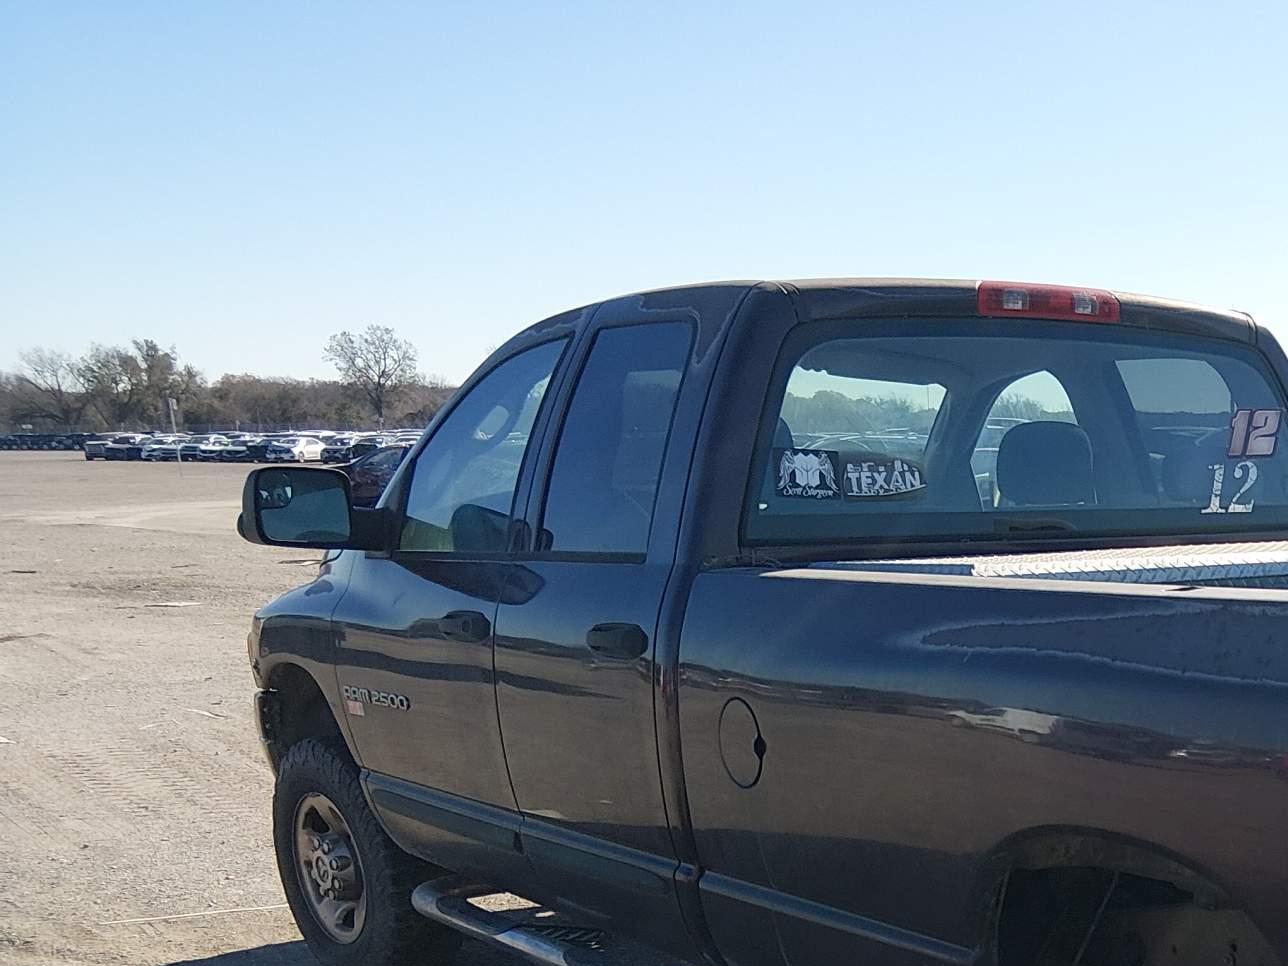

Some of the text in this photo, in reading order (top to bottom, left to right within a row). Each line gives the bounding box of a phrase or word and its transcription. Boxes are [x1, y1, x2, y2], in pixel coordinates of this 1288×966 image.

[1227, 409, 1281, 457] 12
[847, 471, 921, 490] TEXAN
[1200, 461, 1258, 513] 12
[343, 685, 409, 711] RAM 2500
